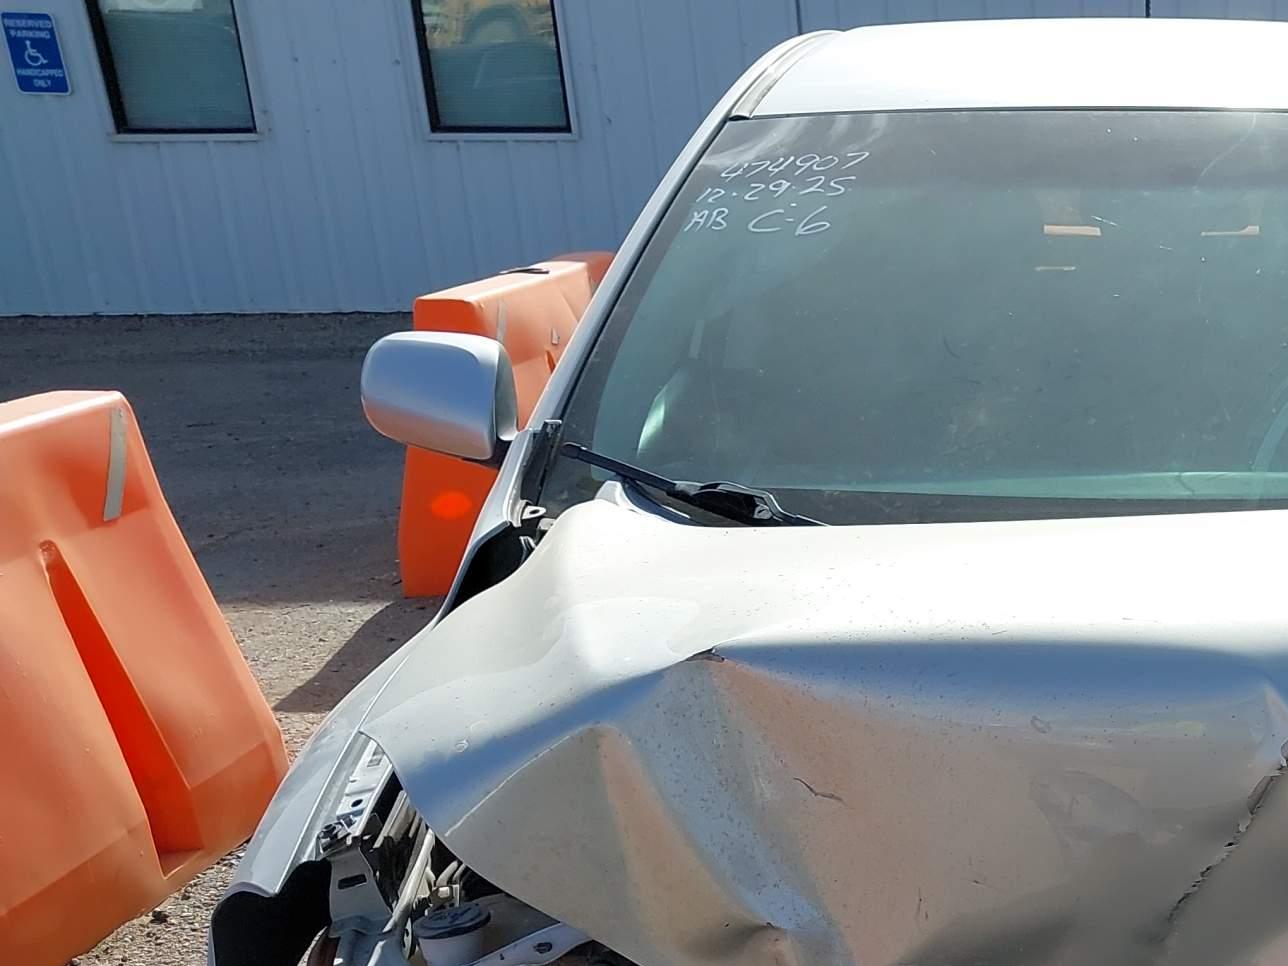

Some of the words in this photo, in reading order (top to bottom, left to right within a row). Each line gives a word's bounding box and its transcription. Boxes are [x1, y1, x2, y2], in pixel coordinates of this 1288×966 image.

[4, 19, 52, 28] RESERVED
[9, 29, 51, 38] PARKING
[720, 151, 870, 182] 474907
[683, 207, 729, 232] AB
